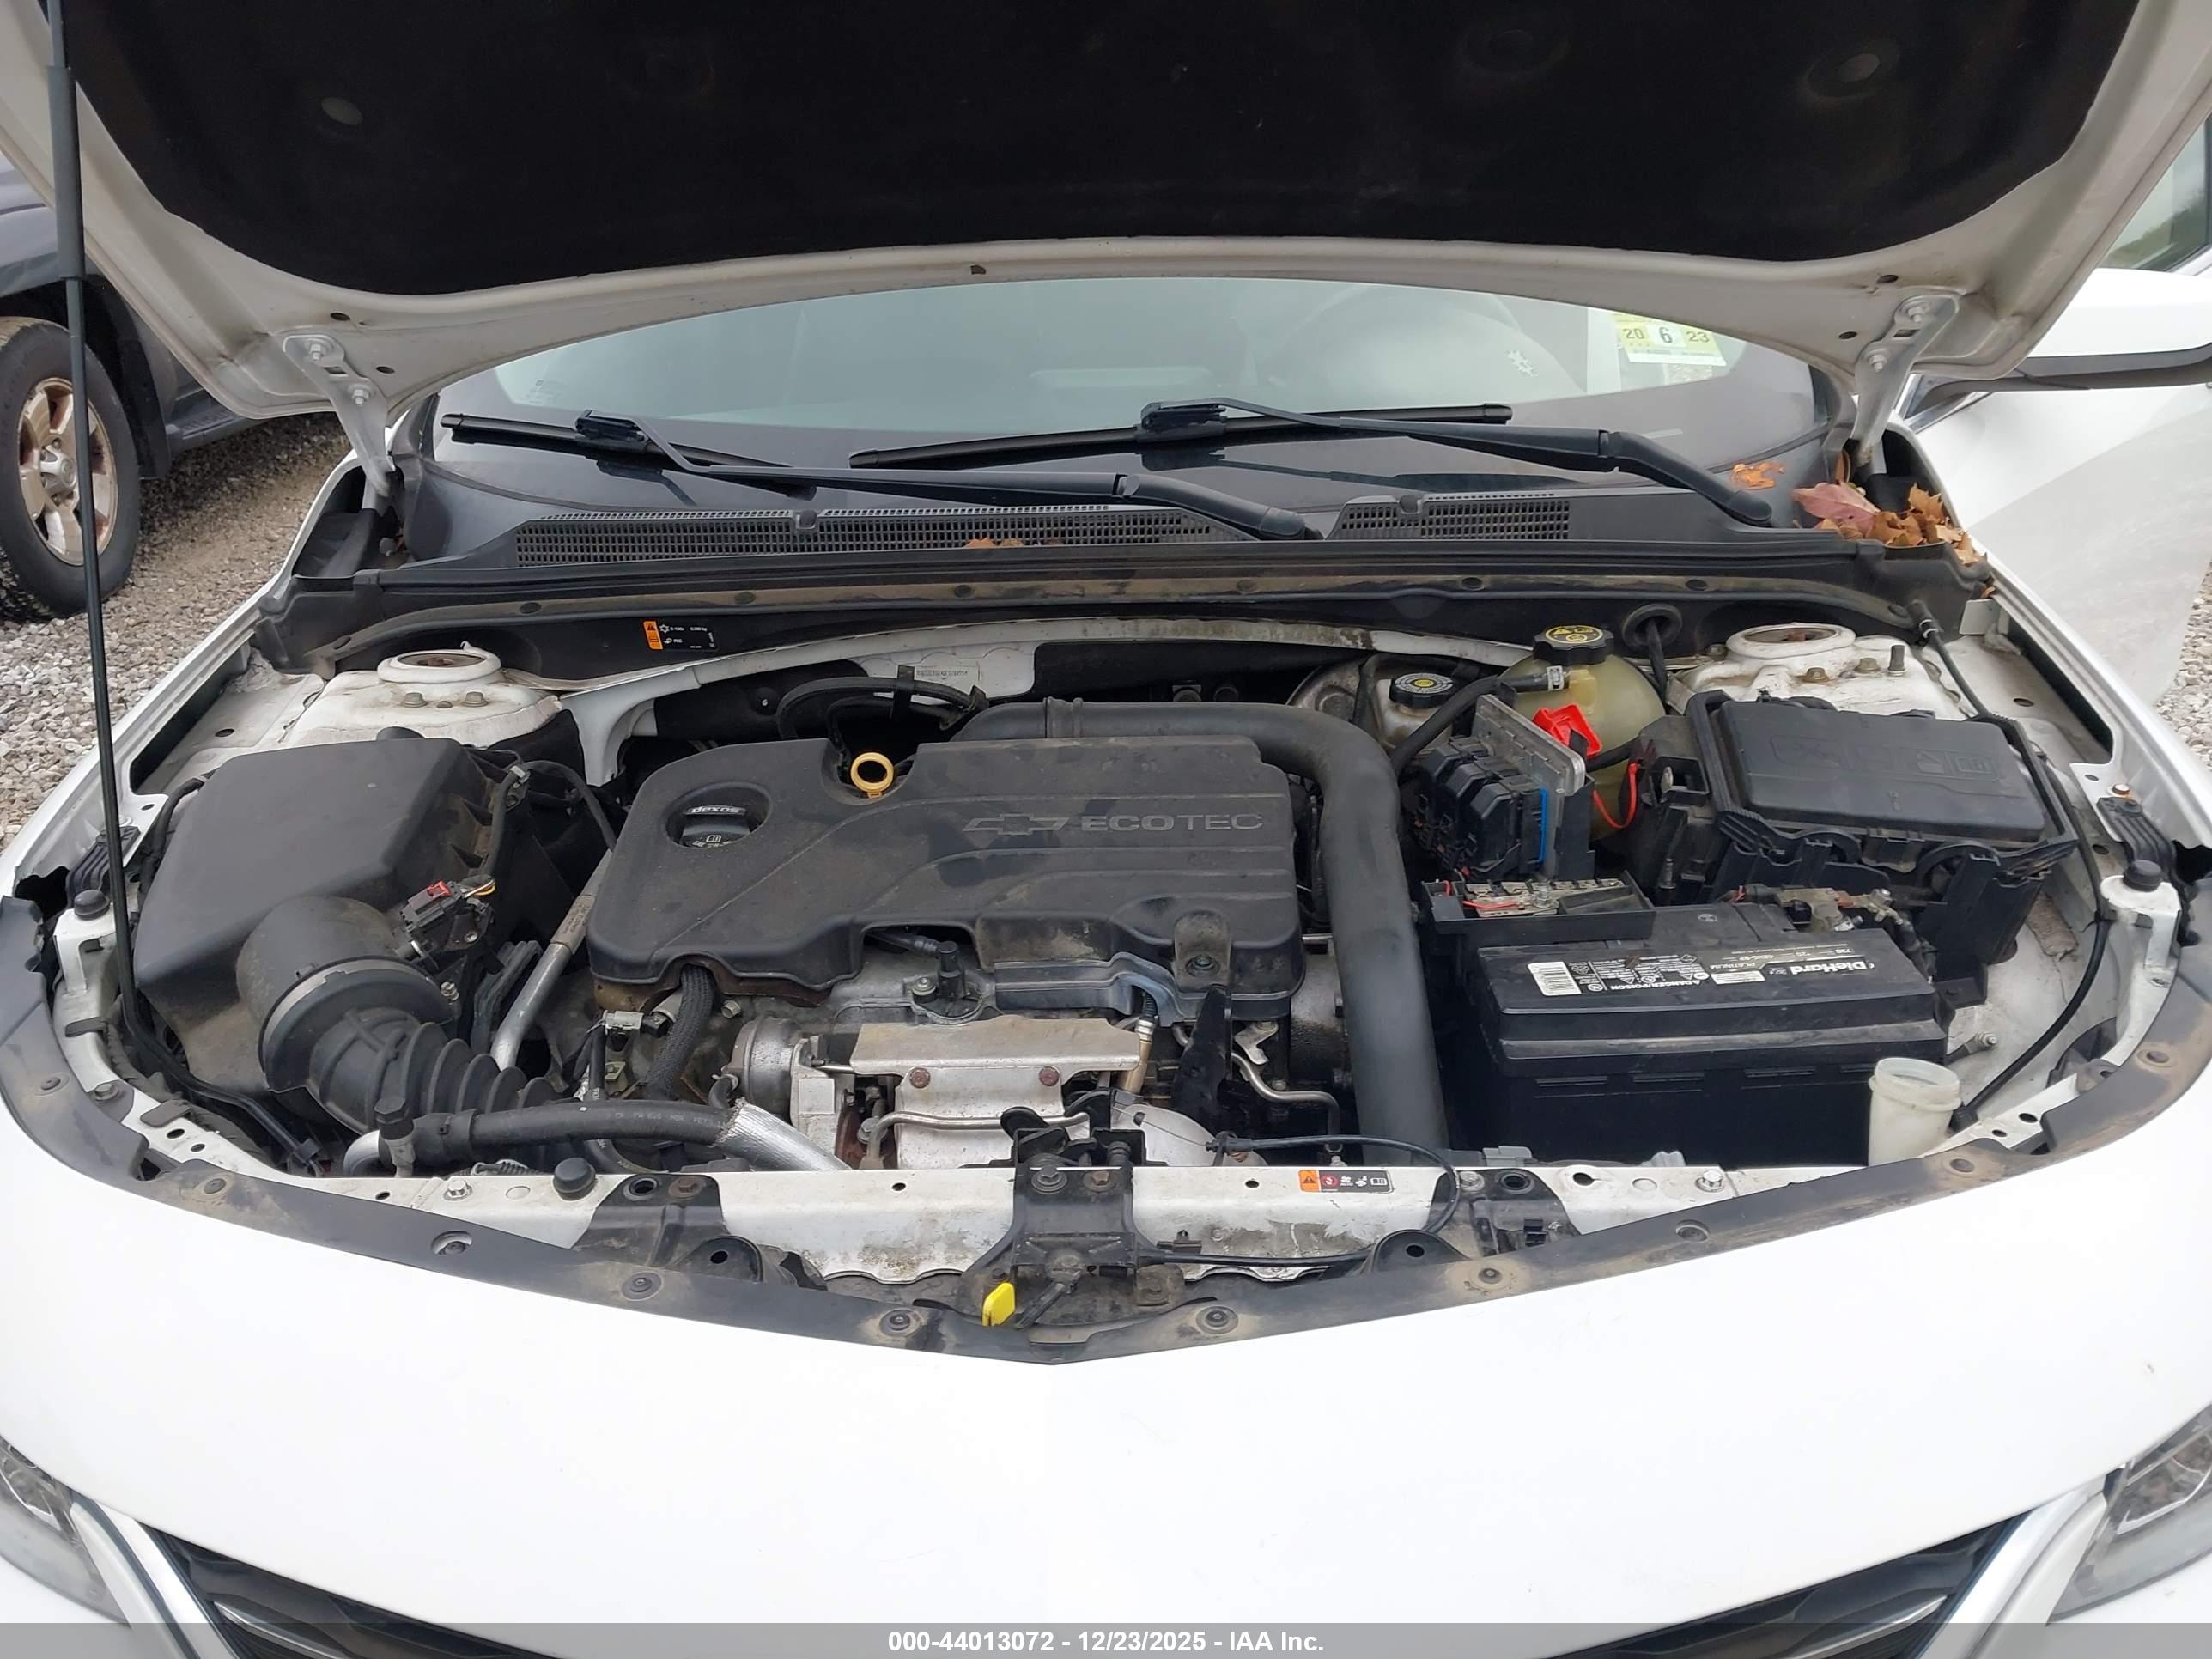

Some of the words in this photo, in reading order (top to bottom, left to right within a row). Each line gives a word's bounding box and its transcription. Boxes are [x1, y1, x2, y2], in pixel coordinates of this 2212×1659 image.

[1623, 328, 1644, 340] 20
[1659, 326, 1673, 343] 6
[1686, 331, 1710, 343] 23
[1080, 813, 1264, 831] ECOTEC
[1790, 959, 1869, 975] DieHard
